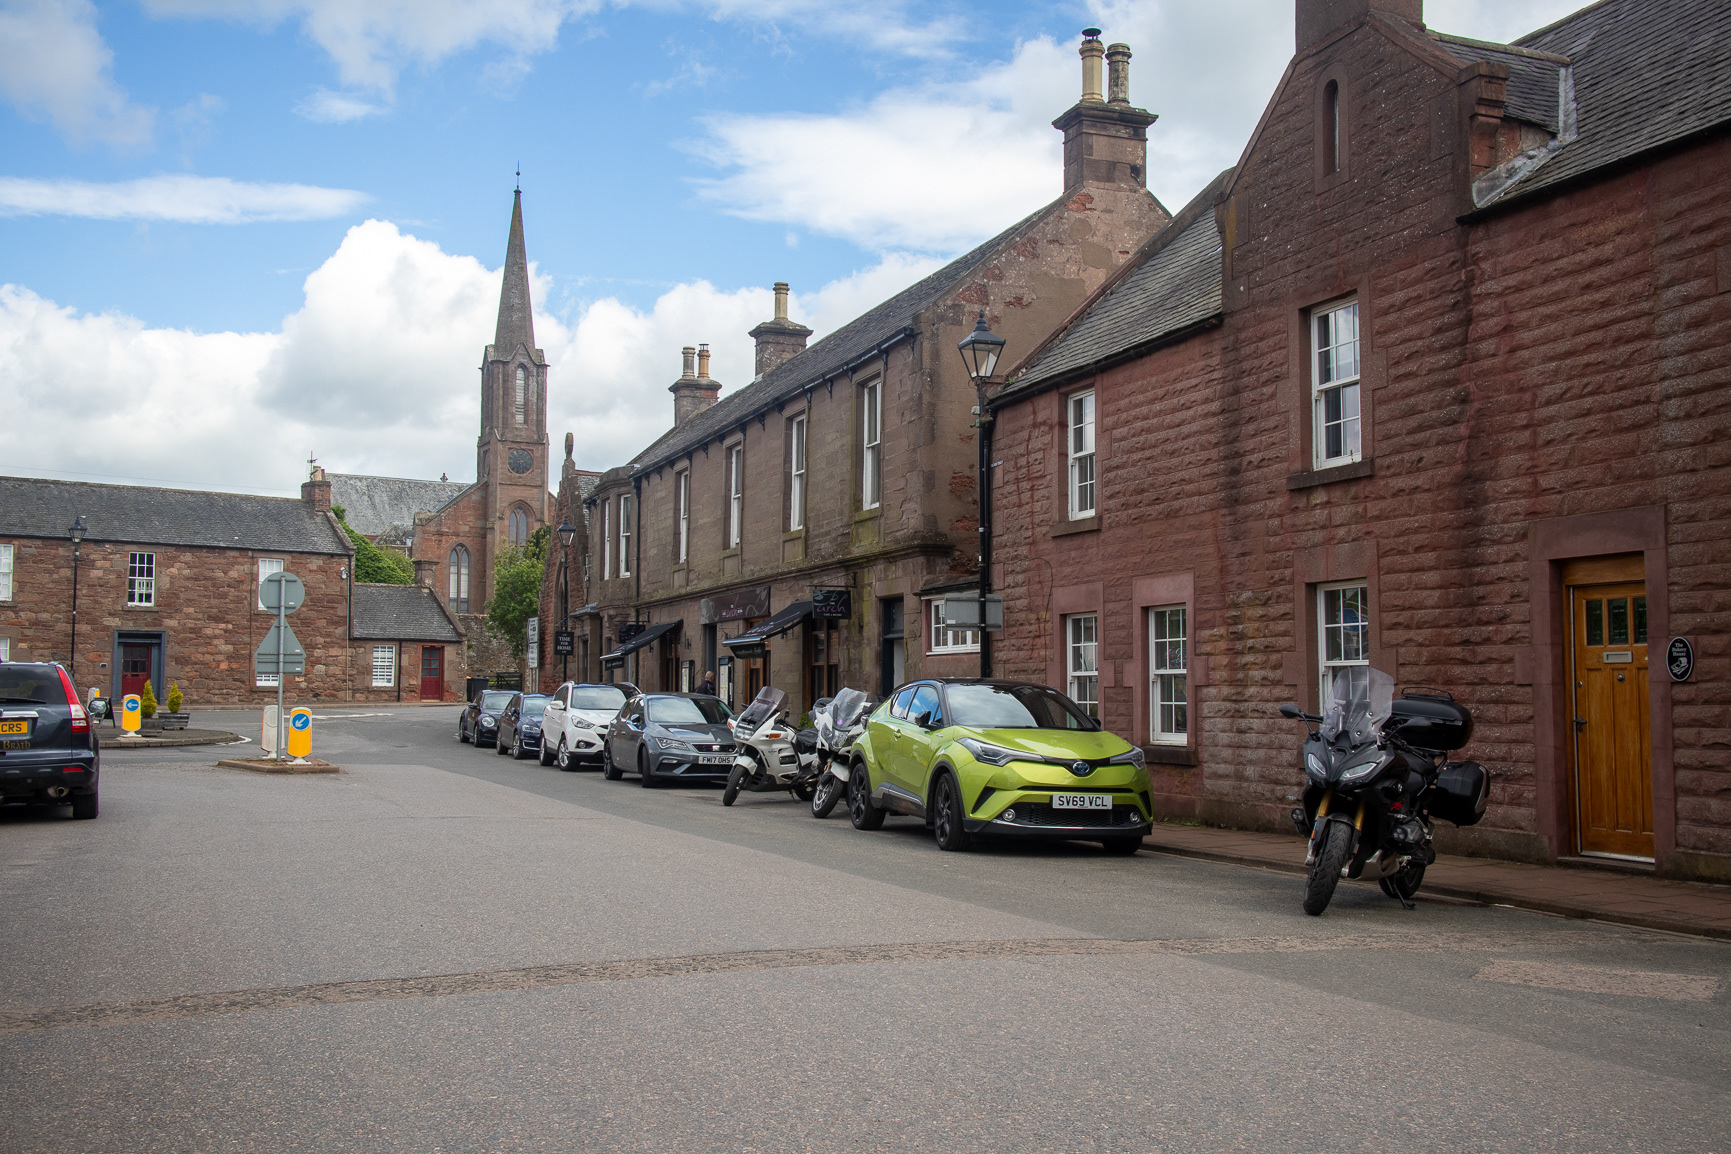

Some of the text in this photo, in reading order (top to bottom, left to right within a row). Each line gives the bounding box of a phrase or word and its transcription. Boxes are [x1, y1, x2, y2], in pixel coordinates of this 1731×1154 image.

[816, 593, 848, 613] arch
[1, 723, 22, 732] CRS
[1058, 796, 1107, 807] SV69 VCL
